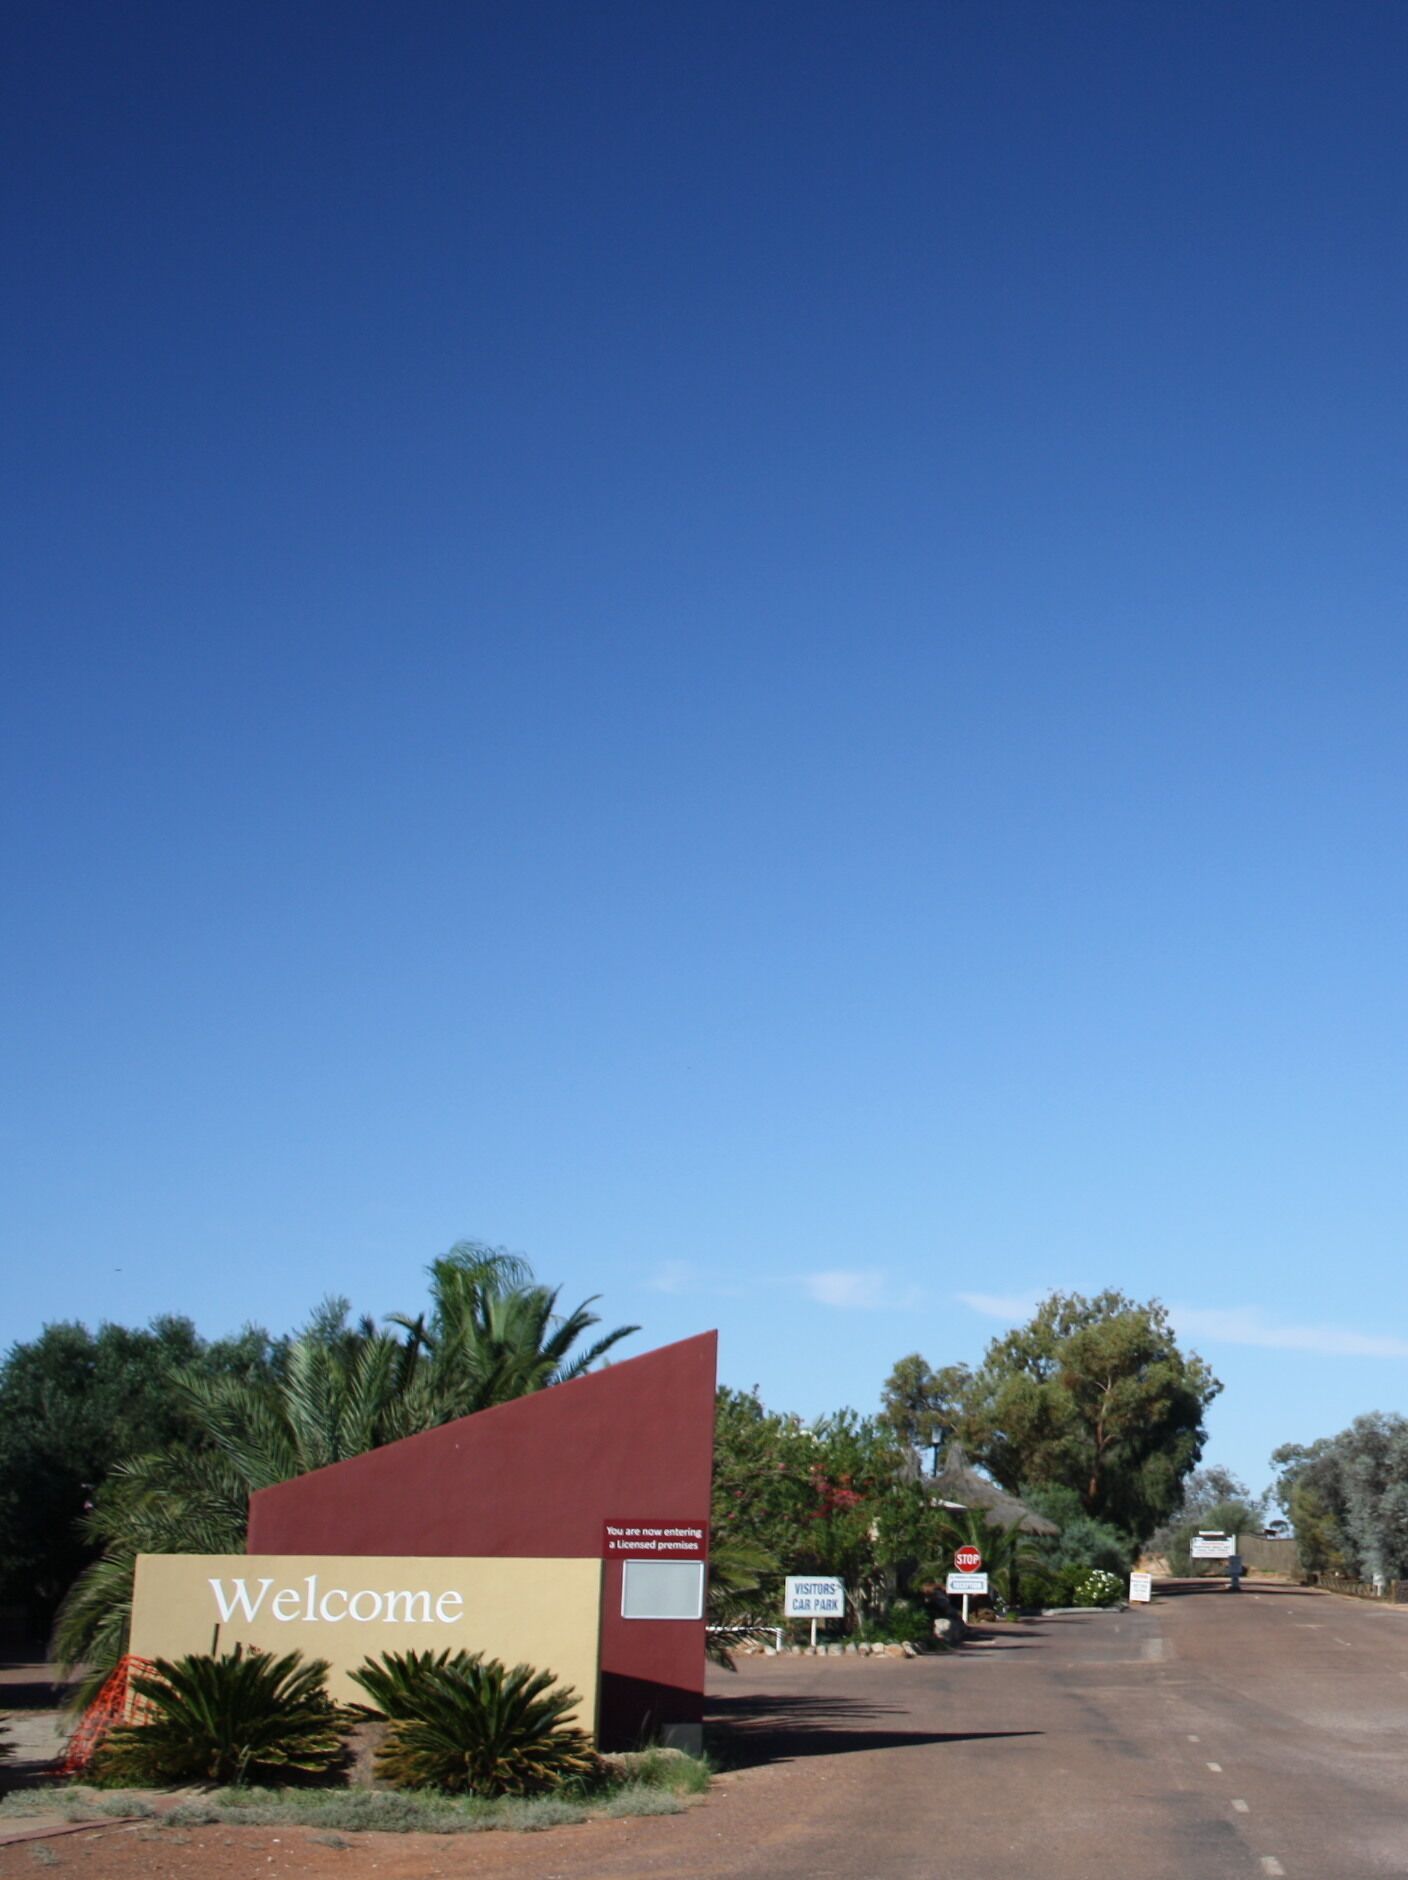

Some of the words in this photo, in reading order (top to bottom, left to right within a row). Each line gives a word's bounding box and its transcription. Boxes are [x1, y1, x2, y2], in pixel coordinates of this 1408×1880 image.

[606, 1526, 624, 1536] You
[625, 1527, 641, 1536] are
[642, 1528, 662, 1536] now
[664, 1527, 703, 1539] entering
[608, 1540, 615, 1549] a
[617, 1540, 656, 1549] Licensed
[658, 1541, 699, 1551] premises
[956, 1553, 981, 1566] STOP
[794, 1583, 836, 1595] VISITORS
[207, 1574, 464, 1624] Welcome
[792, 1599, 811, 1611] CAR
[814, 1599, 839, 1611] PARK
